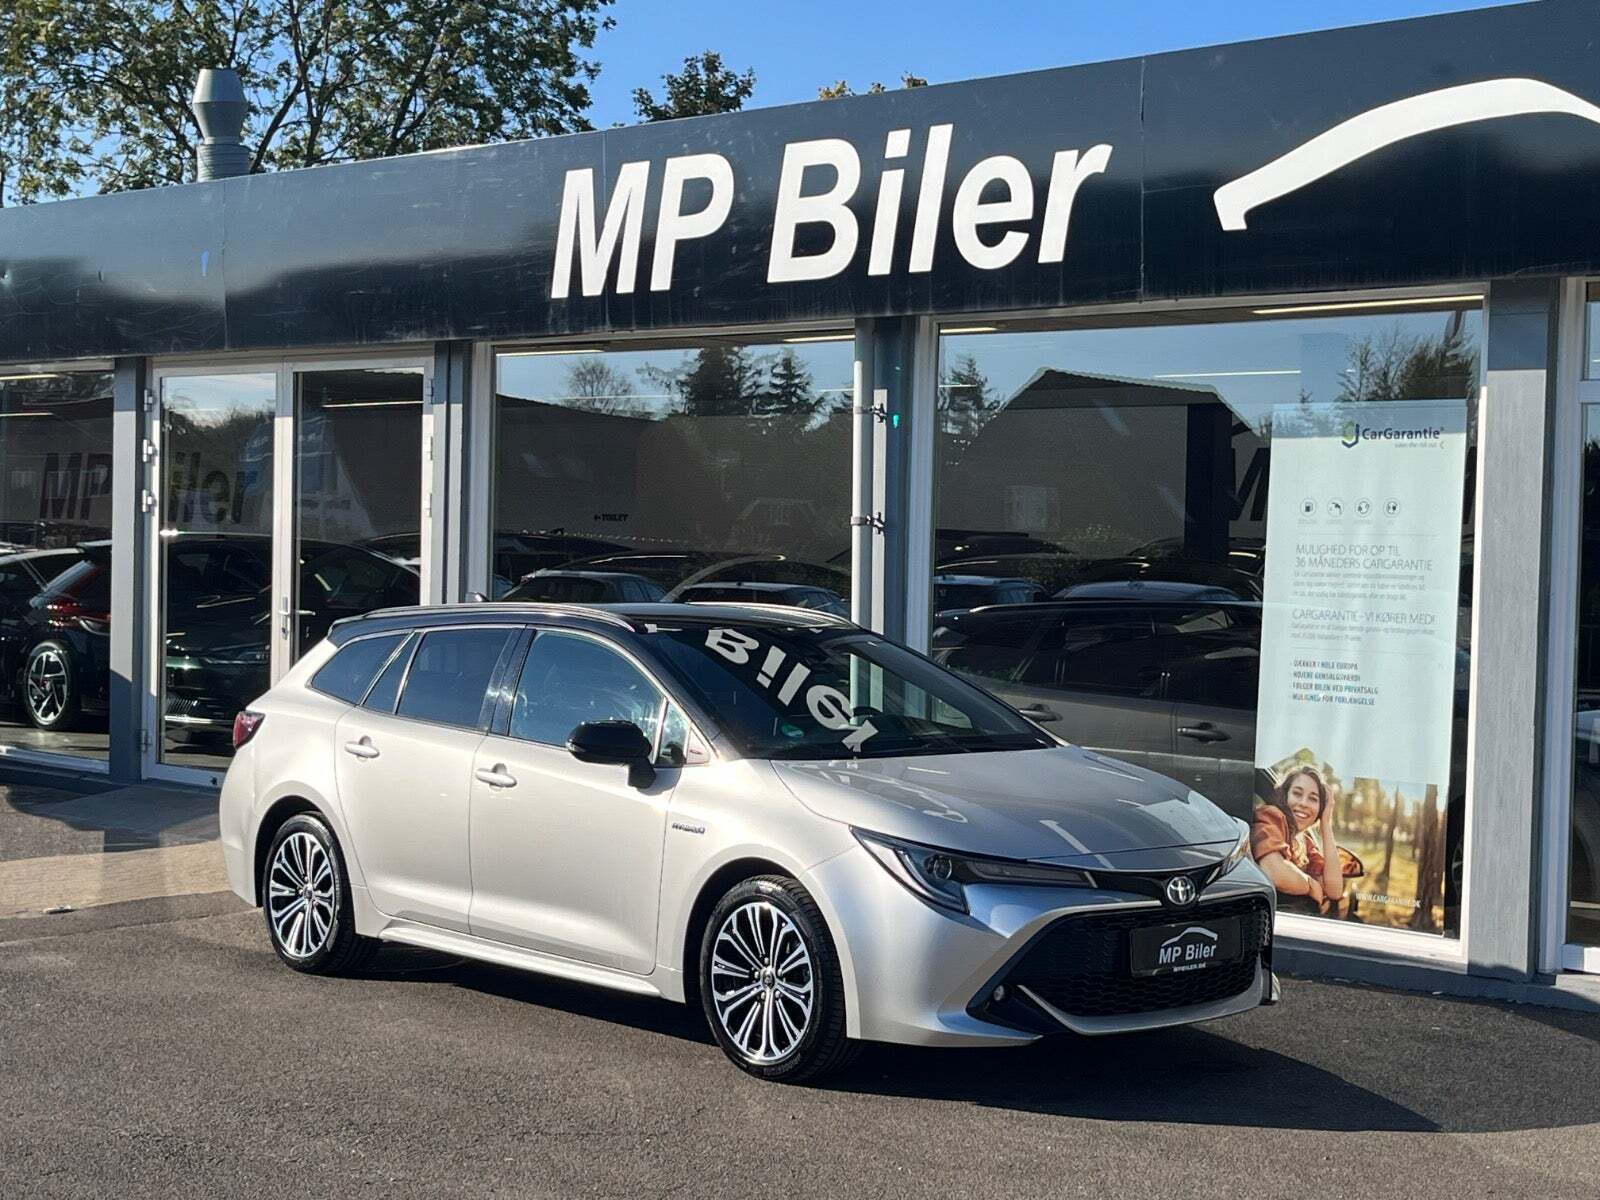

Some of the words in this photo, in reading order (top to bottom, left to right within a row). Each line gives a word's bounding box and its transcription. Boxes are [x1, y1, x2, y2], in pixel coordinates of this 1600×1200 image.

[551, 153, 735, 299] MP
[767, 123, 1113, 284] Biler
[1361, 427, 1441, 440] CarGarantie
[1349, 545, 1368, 556] FOR
[1370, 545, 1385, 556] OP
[1388, 545, 1400, 557] TIL
[1294, 556, 1306, 567] 36
[1363, 558, 1433, 571] CARGARANTIE
[1291, 609, 1359, 622] CARGARANTIE
[1159, 946, 1182, 964] MP
[1185, 942, 1217, 960] Biler
